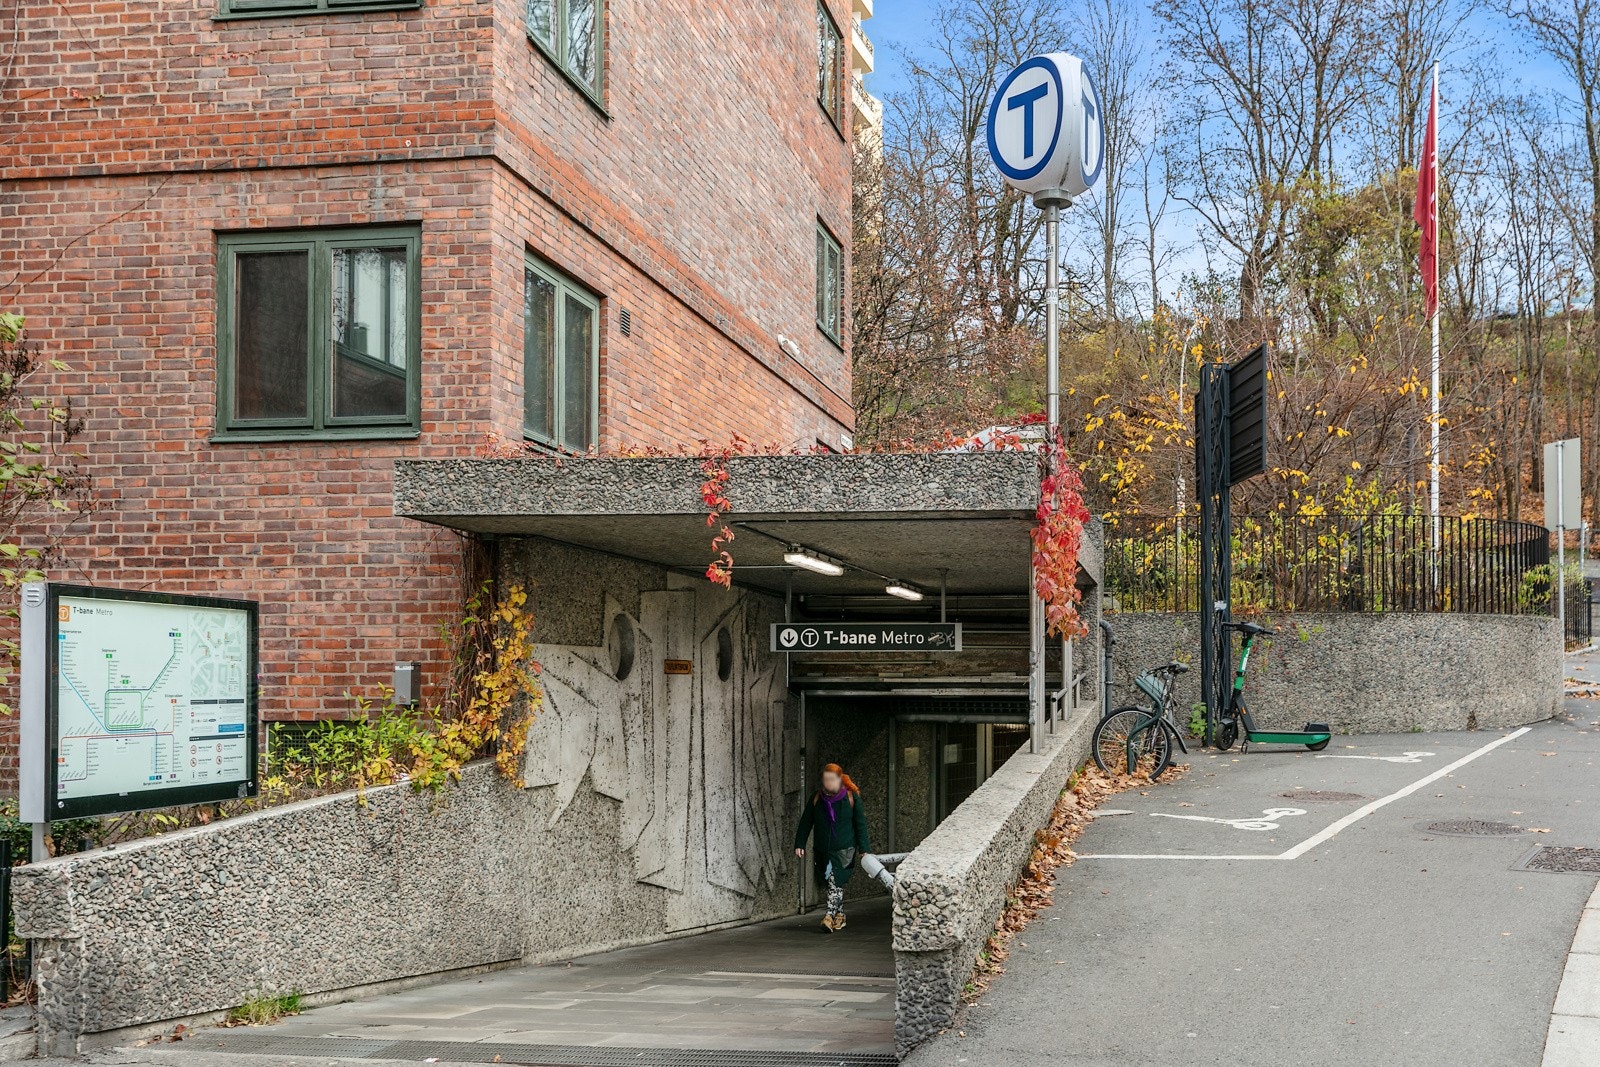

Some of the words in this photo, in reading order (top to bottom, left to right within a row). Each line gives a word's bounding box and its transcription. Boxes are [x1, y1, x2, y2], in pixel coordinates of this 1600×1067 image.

[1007, 81, 1049, 160] T
[1081, 89, 1095, 166] T
[73, 606, 94, 615] T-bane
[96, 608, 113, 616] Metro
[824, 630, 877, 645] T-bane
[882, 630, 925, 645] Metro
